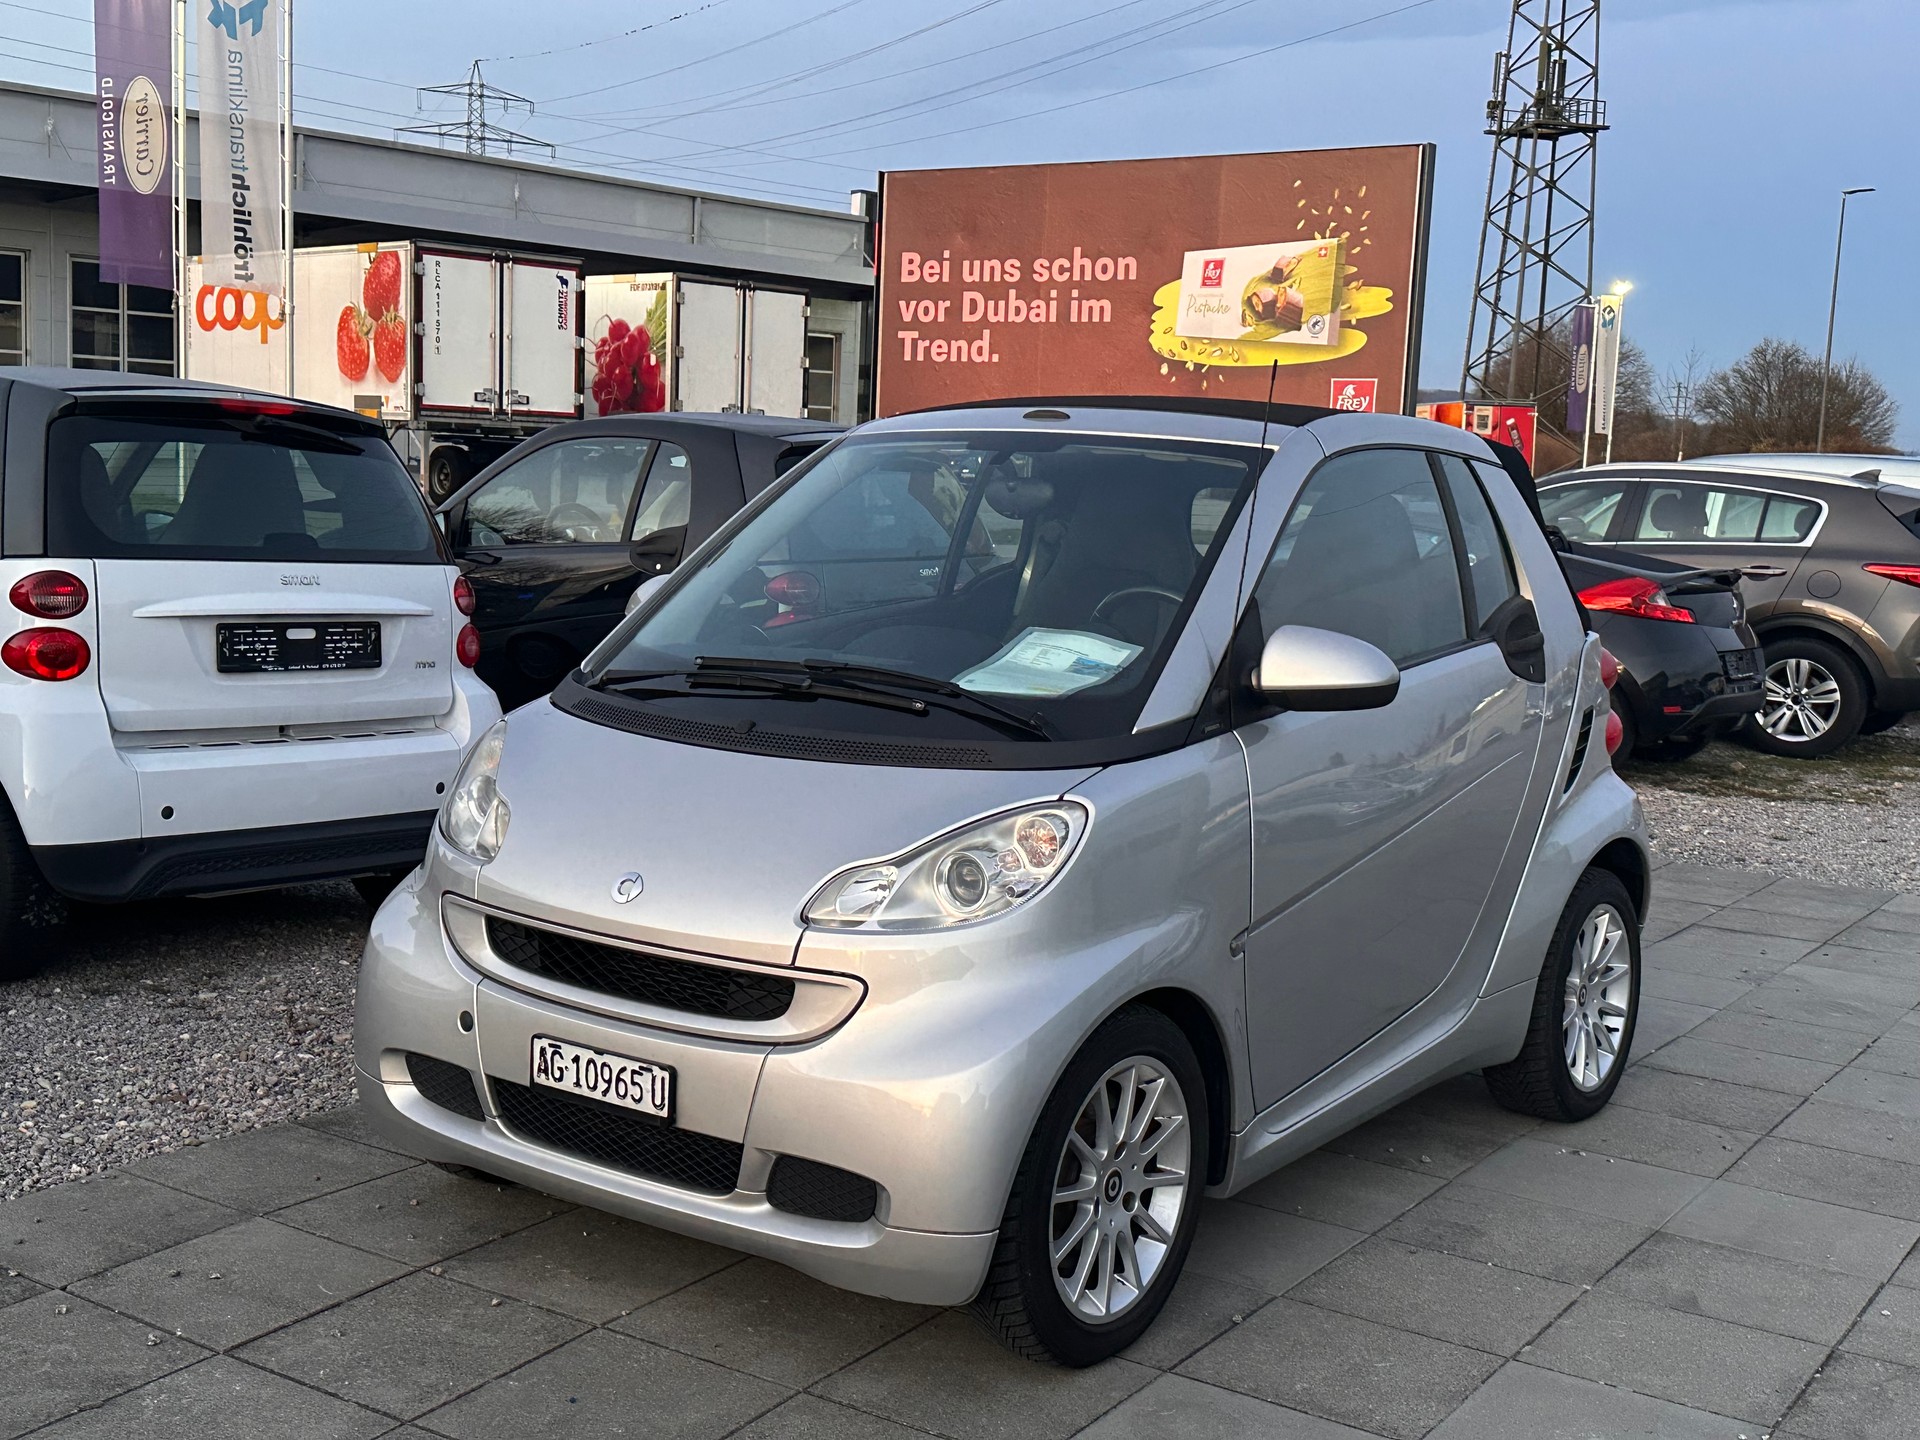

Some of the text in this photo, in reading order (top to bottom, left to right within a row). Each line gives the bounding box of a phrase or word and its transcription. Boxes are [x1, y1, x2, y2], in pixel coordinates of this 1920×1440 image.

[900, 246, 1137, 283] Bei uns schon
[195, 283, 286, 345] coop
[898, 288, 1112, 323] vor Dubai im
[1186, 293, 1232, 318] Pistache
[897, 328, 1000, 363] Trend.
[1335, 395, 1370, 412] FREY
[280, 573, 321, 586] smart
